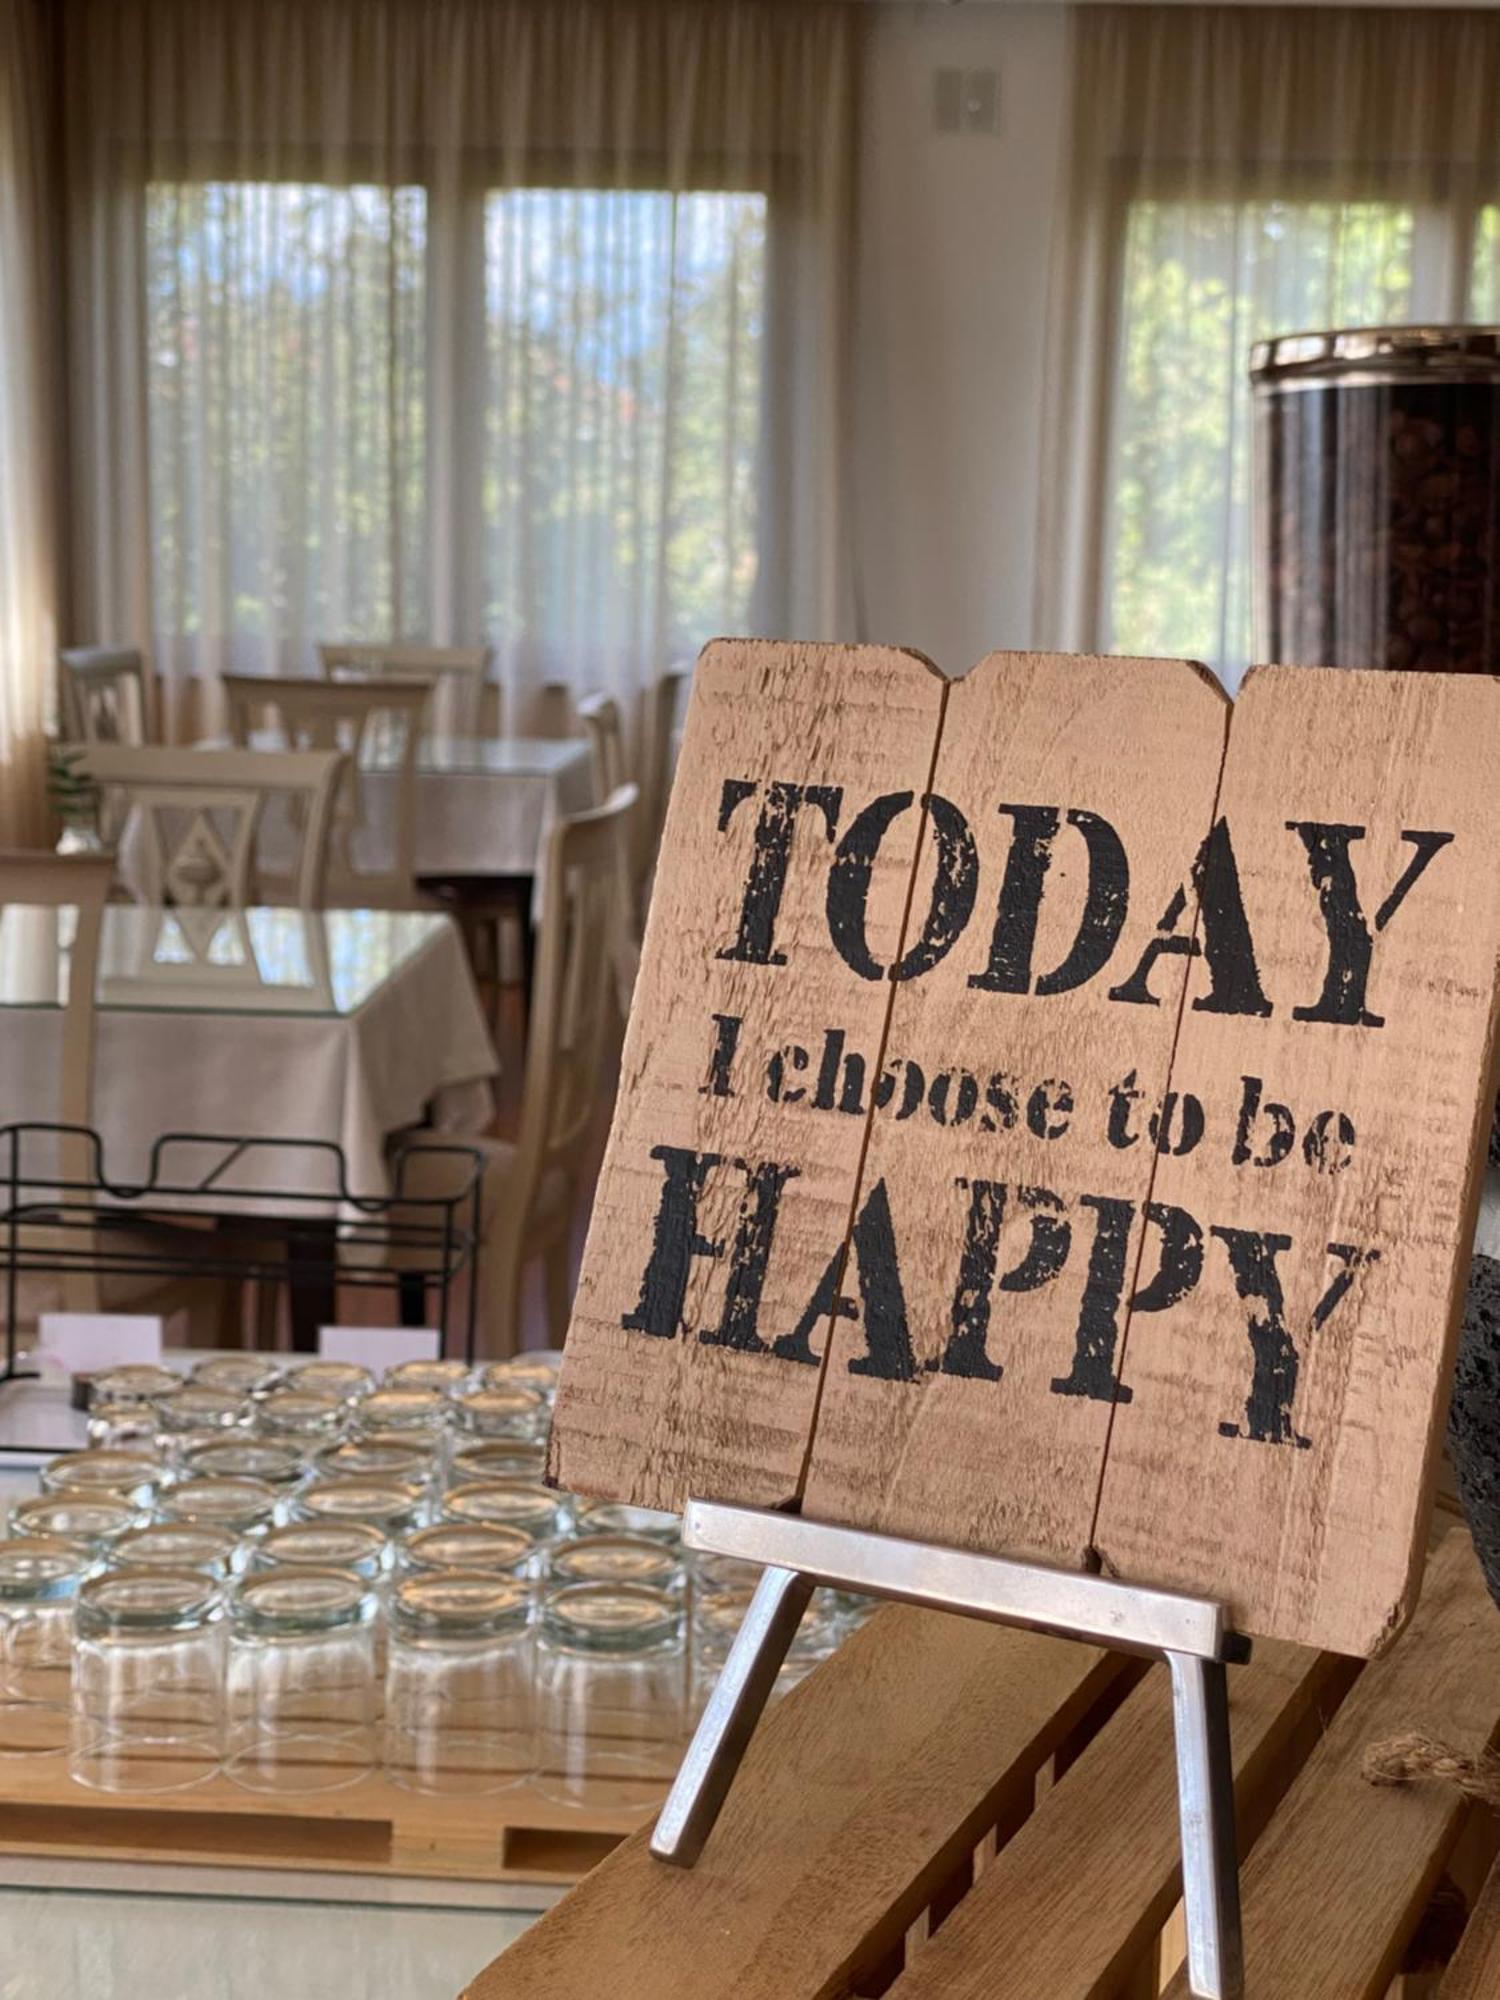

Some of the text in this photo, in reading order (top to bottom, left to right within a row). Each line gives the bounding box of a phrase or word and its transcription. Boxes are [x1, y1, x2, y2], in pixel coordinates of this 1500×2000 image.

[714, 779, 1455, 1028] TODAY
[698, 1014, 1356, 1174] I choose to be
[621, 1145, 1381, 1449] HAPPY
